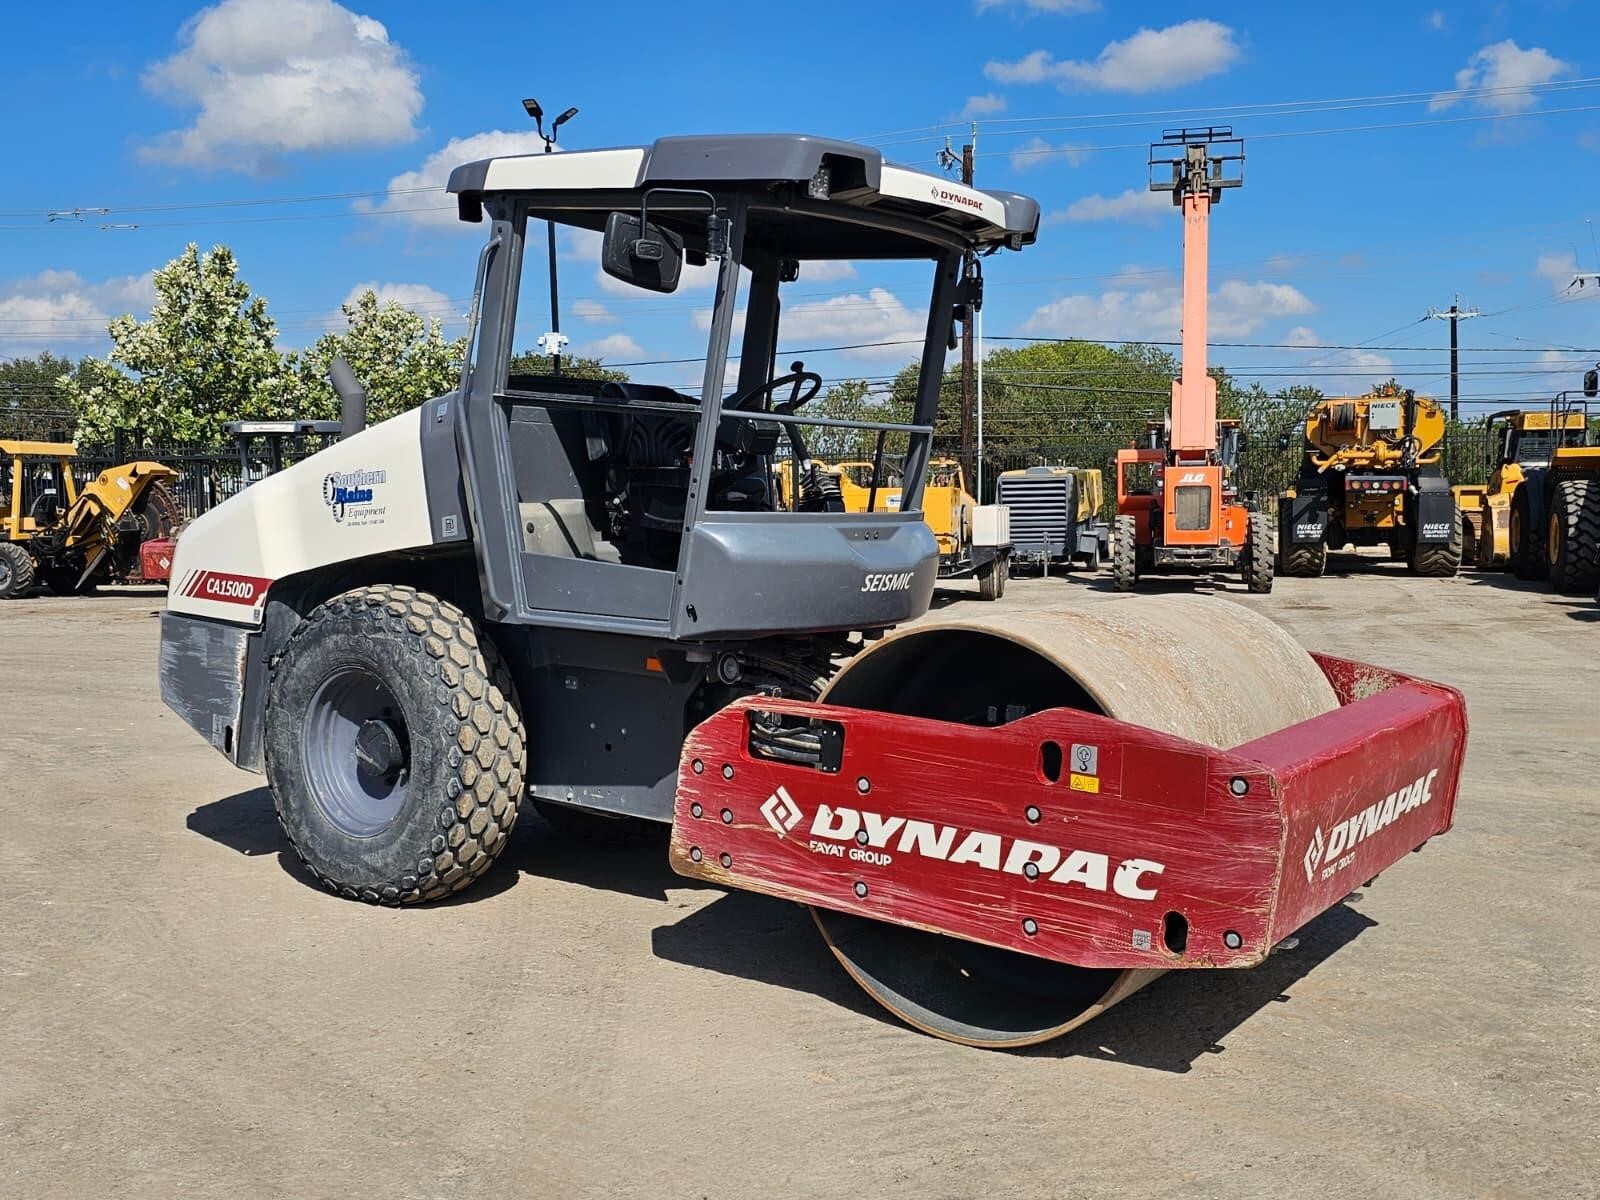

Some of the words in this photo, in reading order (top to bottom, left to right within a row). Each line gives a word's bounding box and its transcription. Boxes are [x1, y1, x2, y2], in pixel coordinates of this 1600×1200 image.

[940, 191, 983, 211] DYNAPAC
[333, 469, 387, 488] Southern
[1179, 474, 1205, 483] JLG
[335, 486, 373, 504] Plains
[348, 506, 386, 520] Equipment
[206, 578, 254, 599] CA1500D
[861, 572, 915, 592] SEISMIC
[1324, 768, 1438, 865] DYNAPAC
[809, 840, 845, 857] FAYAT
[848, 847, 892, 867] GROUP
[810, 803, 1165, 901] DYNAPAC
